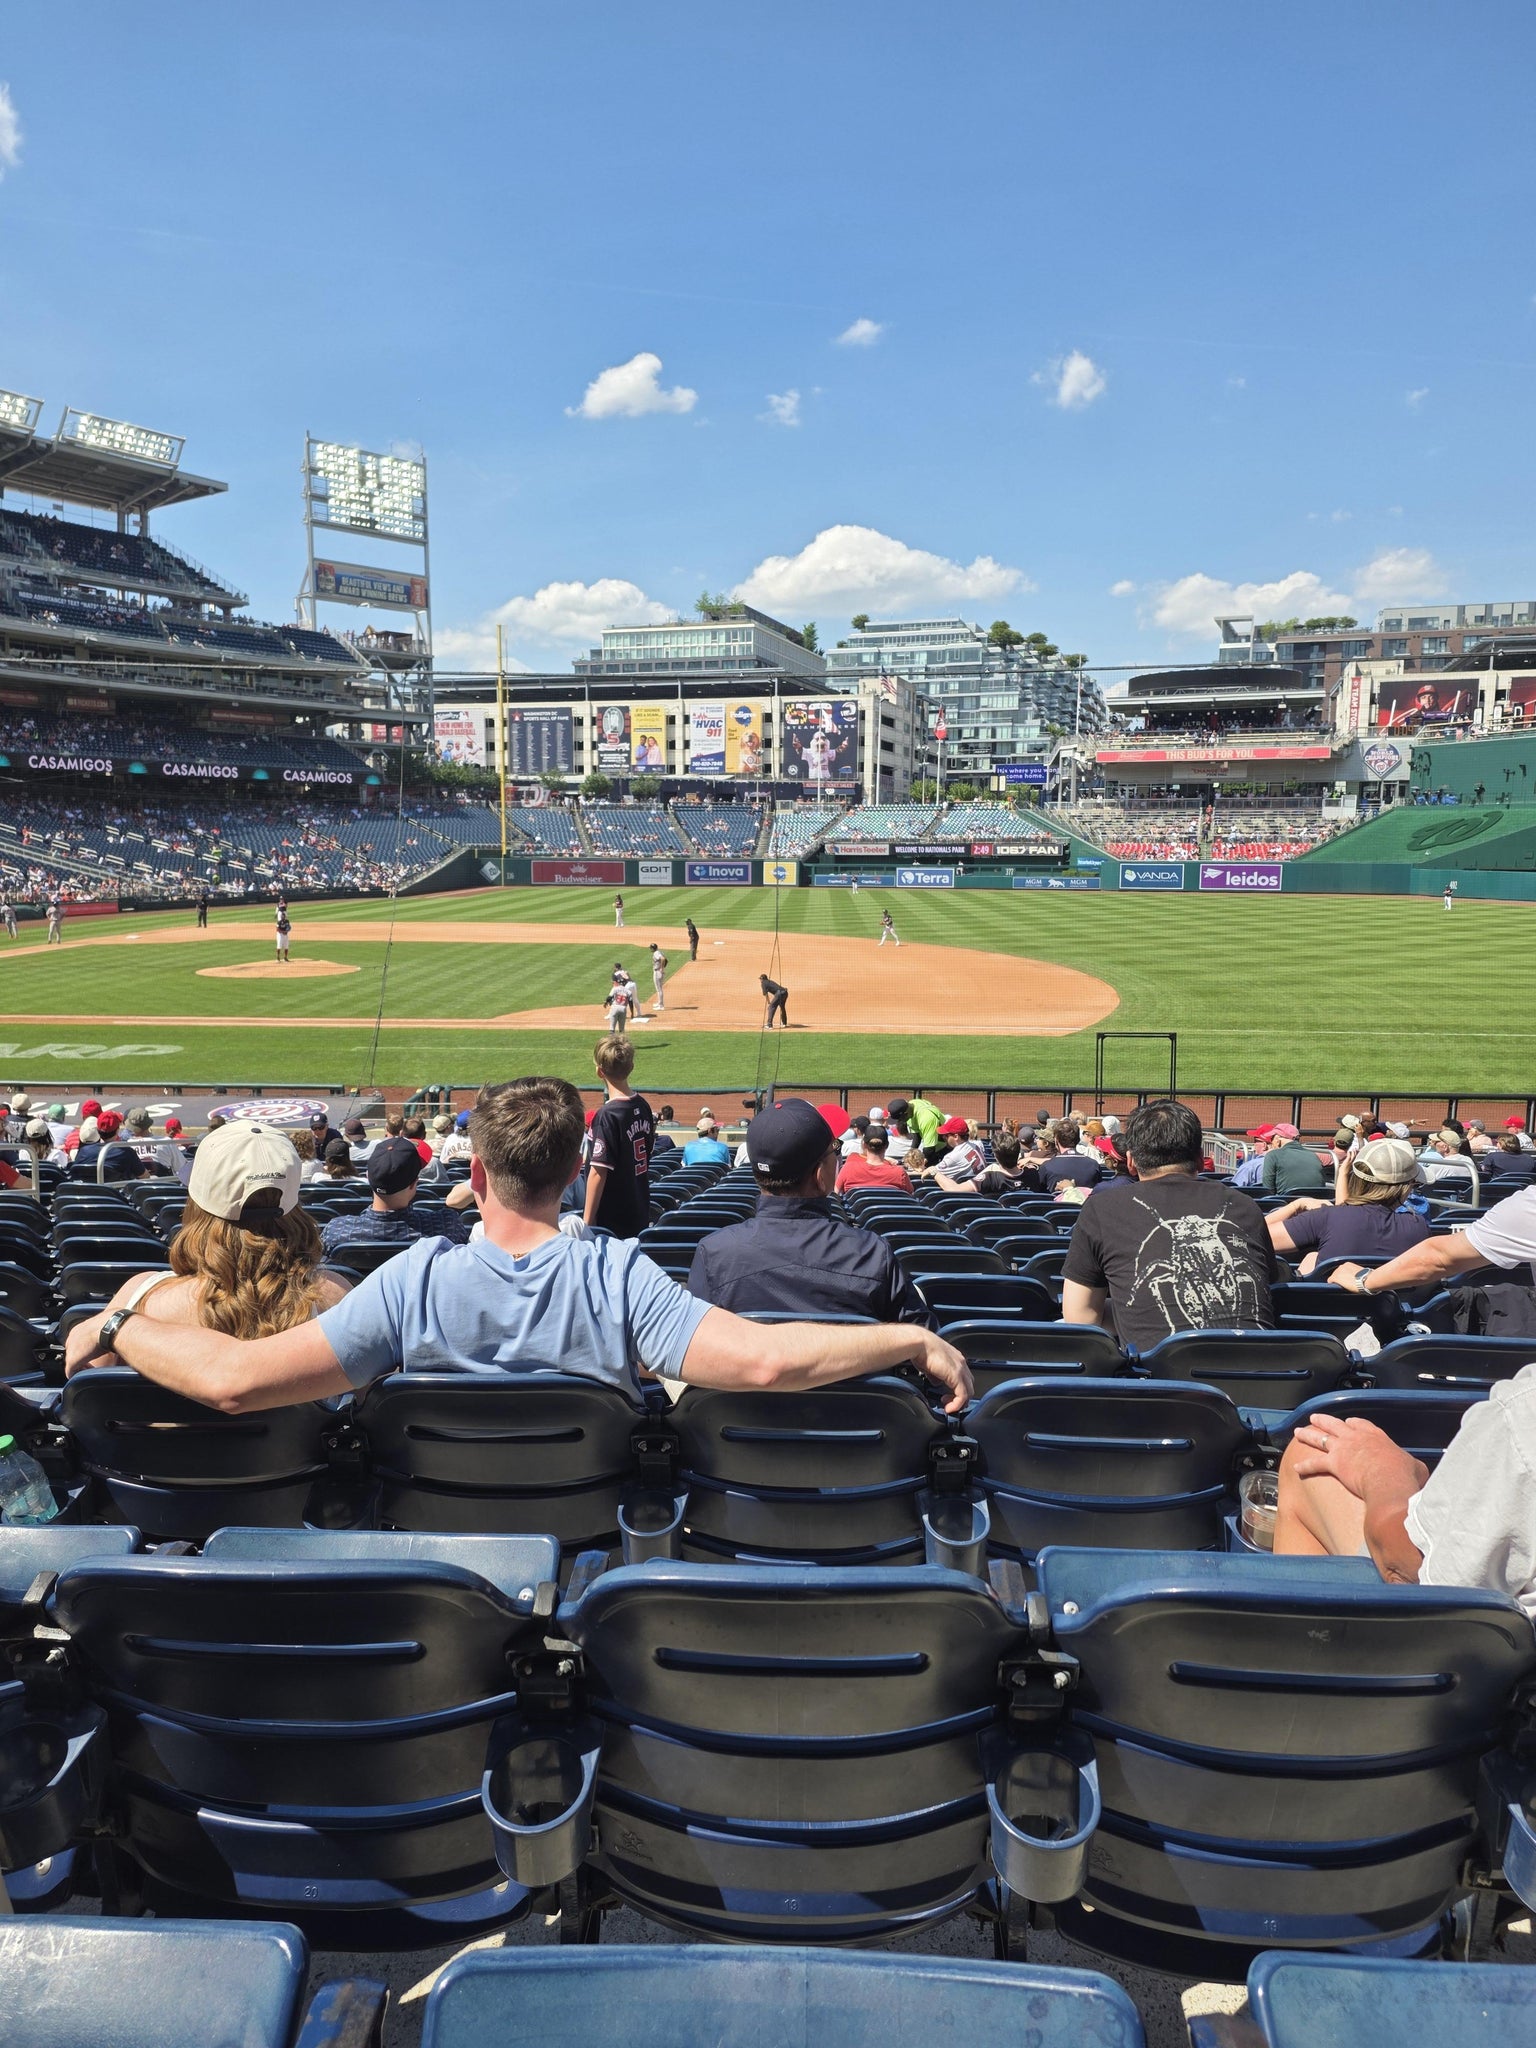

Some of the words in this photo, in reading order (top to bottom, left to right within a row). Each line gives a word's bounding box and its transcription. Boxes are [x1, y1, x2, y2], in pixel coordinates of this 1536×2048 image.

[341, 576, 372, 589] BEAUTIFUL
[373, 582, 392, 591] VIEWS
[392, 585, 405, 594] AND
[338, 585, 360, 596] AWARD
[361, 589, 387, 601] WINNING
[387, 593, 408, 604] BREWS
[1351, 687, 1359, 708] TEAM
[696, 719, 723, 729] HVAC
[706, 728, 722, 737] 911
[1166, 751, 1185, 760] THIS
[1187, 750, 1214, 760] BUD'S
[1215, 750, 1233, 759] FOR
[1235, 749, 1257, 759] YOU.
[28, 755, 113, 772] CASAMIGOS
[162, 763, 239, 778] CASAMIGOS
[282, 769, 353, 784] CASAMIGOS
[840, 845, 862, 854] Harris
[863, 845, 887, 854] Teeter
[895, 846, 918, 854] WELCOME
[925, 846, 951, 854] NATIONALS
[952, 846, 965, 854] PARK
[973, 845, 990, 854] 2:49
[1028, 846, 1058, 855] FAN
[708, 866, 744, 876] Inova
[1136, 871, 1179, 880] VANDA
[554, 874, 603, 884] Budweiser
[915, 872, 950, 884] Terra
[1225, 871, 1279, 887] leidos
[633, 1136, 648, 1177] 5
